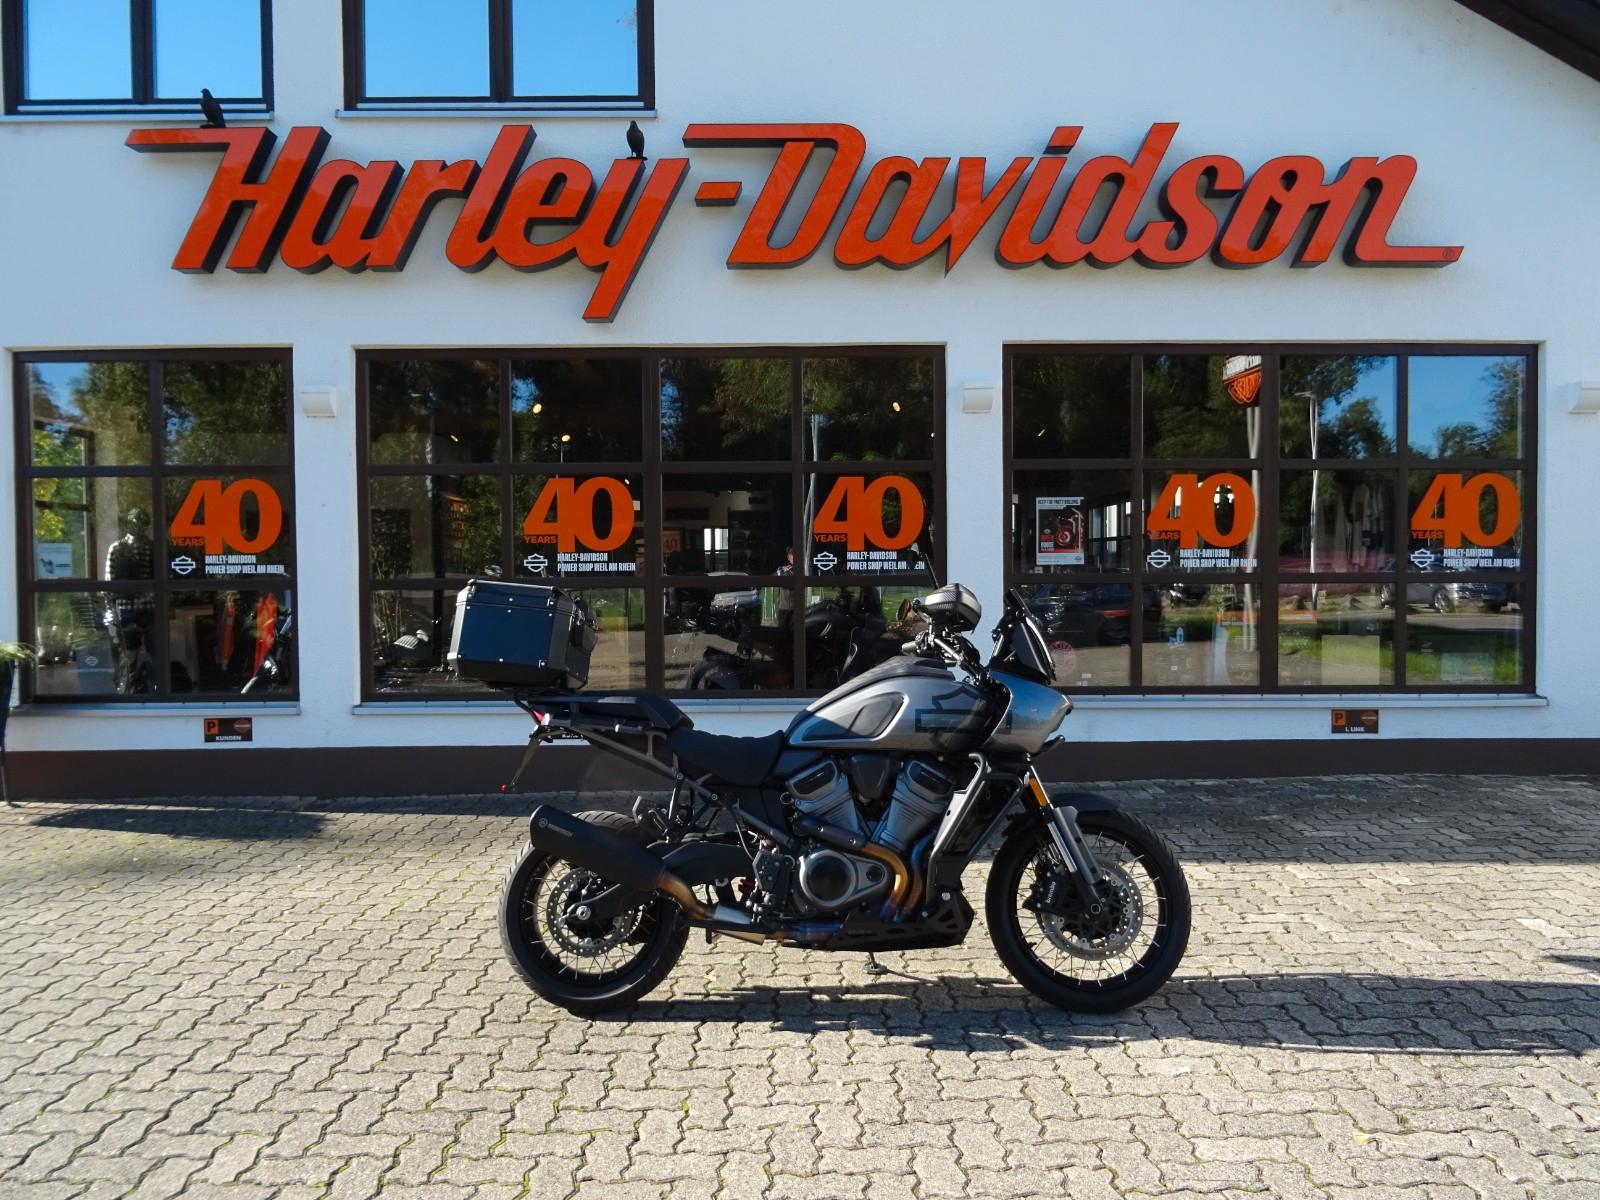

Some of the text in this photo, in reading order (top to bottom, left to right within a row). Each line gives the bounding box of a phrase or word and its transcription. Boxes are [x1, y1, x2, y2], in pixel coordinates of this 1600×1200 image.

[125, 122, 1463, 323] Harley-Davidson
[523, 476, 635, 552] 40
[813, 475, 924, 551] 40
[1147, 472, 1256, 548] 40
[1411, 472, 1520, 548] 40
[171, 479, 282, 555] 40
[814, 534, 847, 542] YEARS
[1147, 531, 1179, 540] YEARS
[1411, 530, 1443, 539] YEARS
[172, 538, 204, 546] YEARS
[557, 553, 608, 561] HARLEY-DAVIDSON
[847, 551, 897, 560] HARLEY-DAVIDSON
[1179, 549, 1230, 557] HARLEY-DAVIDSON
[1443, 548, 1493, 557] HARLEY-DAVIDSON
[205, 555, 257, 564] HARLEY-DAVIDSON
[1180, 559, 1200, 568] POWER
[1201, 559, 1216, 568] SHOP
[1216, 559, 1230, 568] WEIL
[1231, 559, 1239, 568] AM
[1443, 558, 1463, 567] POWER
[1464, 558, 1478, 567] SHOP
[1479, 558, 1493, 567] WEIL
[1493, 558, 1502, 567] AM
[206, 565, 284, 574] POWER SHOP WEIL AM RHEIN
[557, 563, 636, 572] POWER SHOP WEIL AM RHEIN
[847, 561, 867, 570] POWER
[868, 561, 882, 570] SHOP
[883, 561, 898, 570] WEIL
[898, 561, 907, 570] AM
